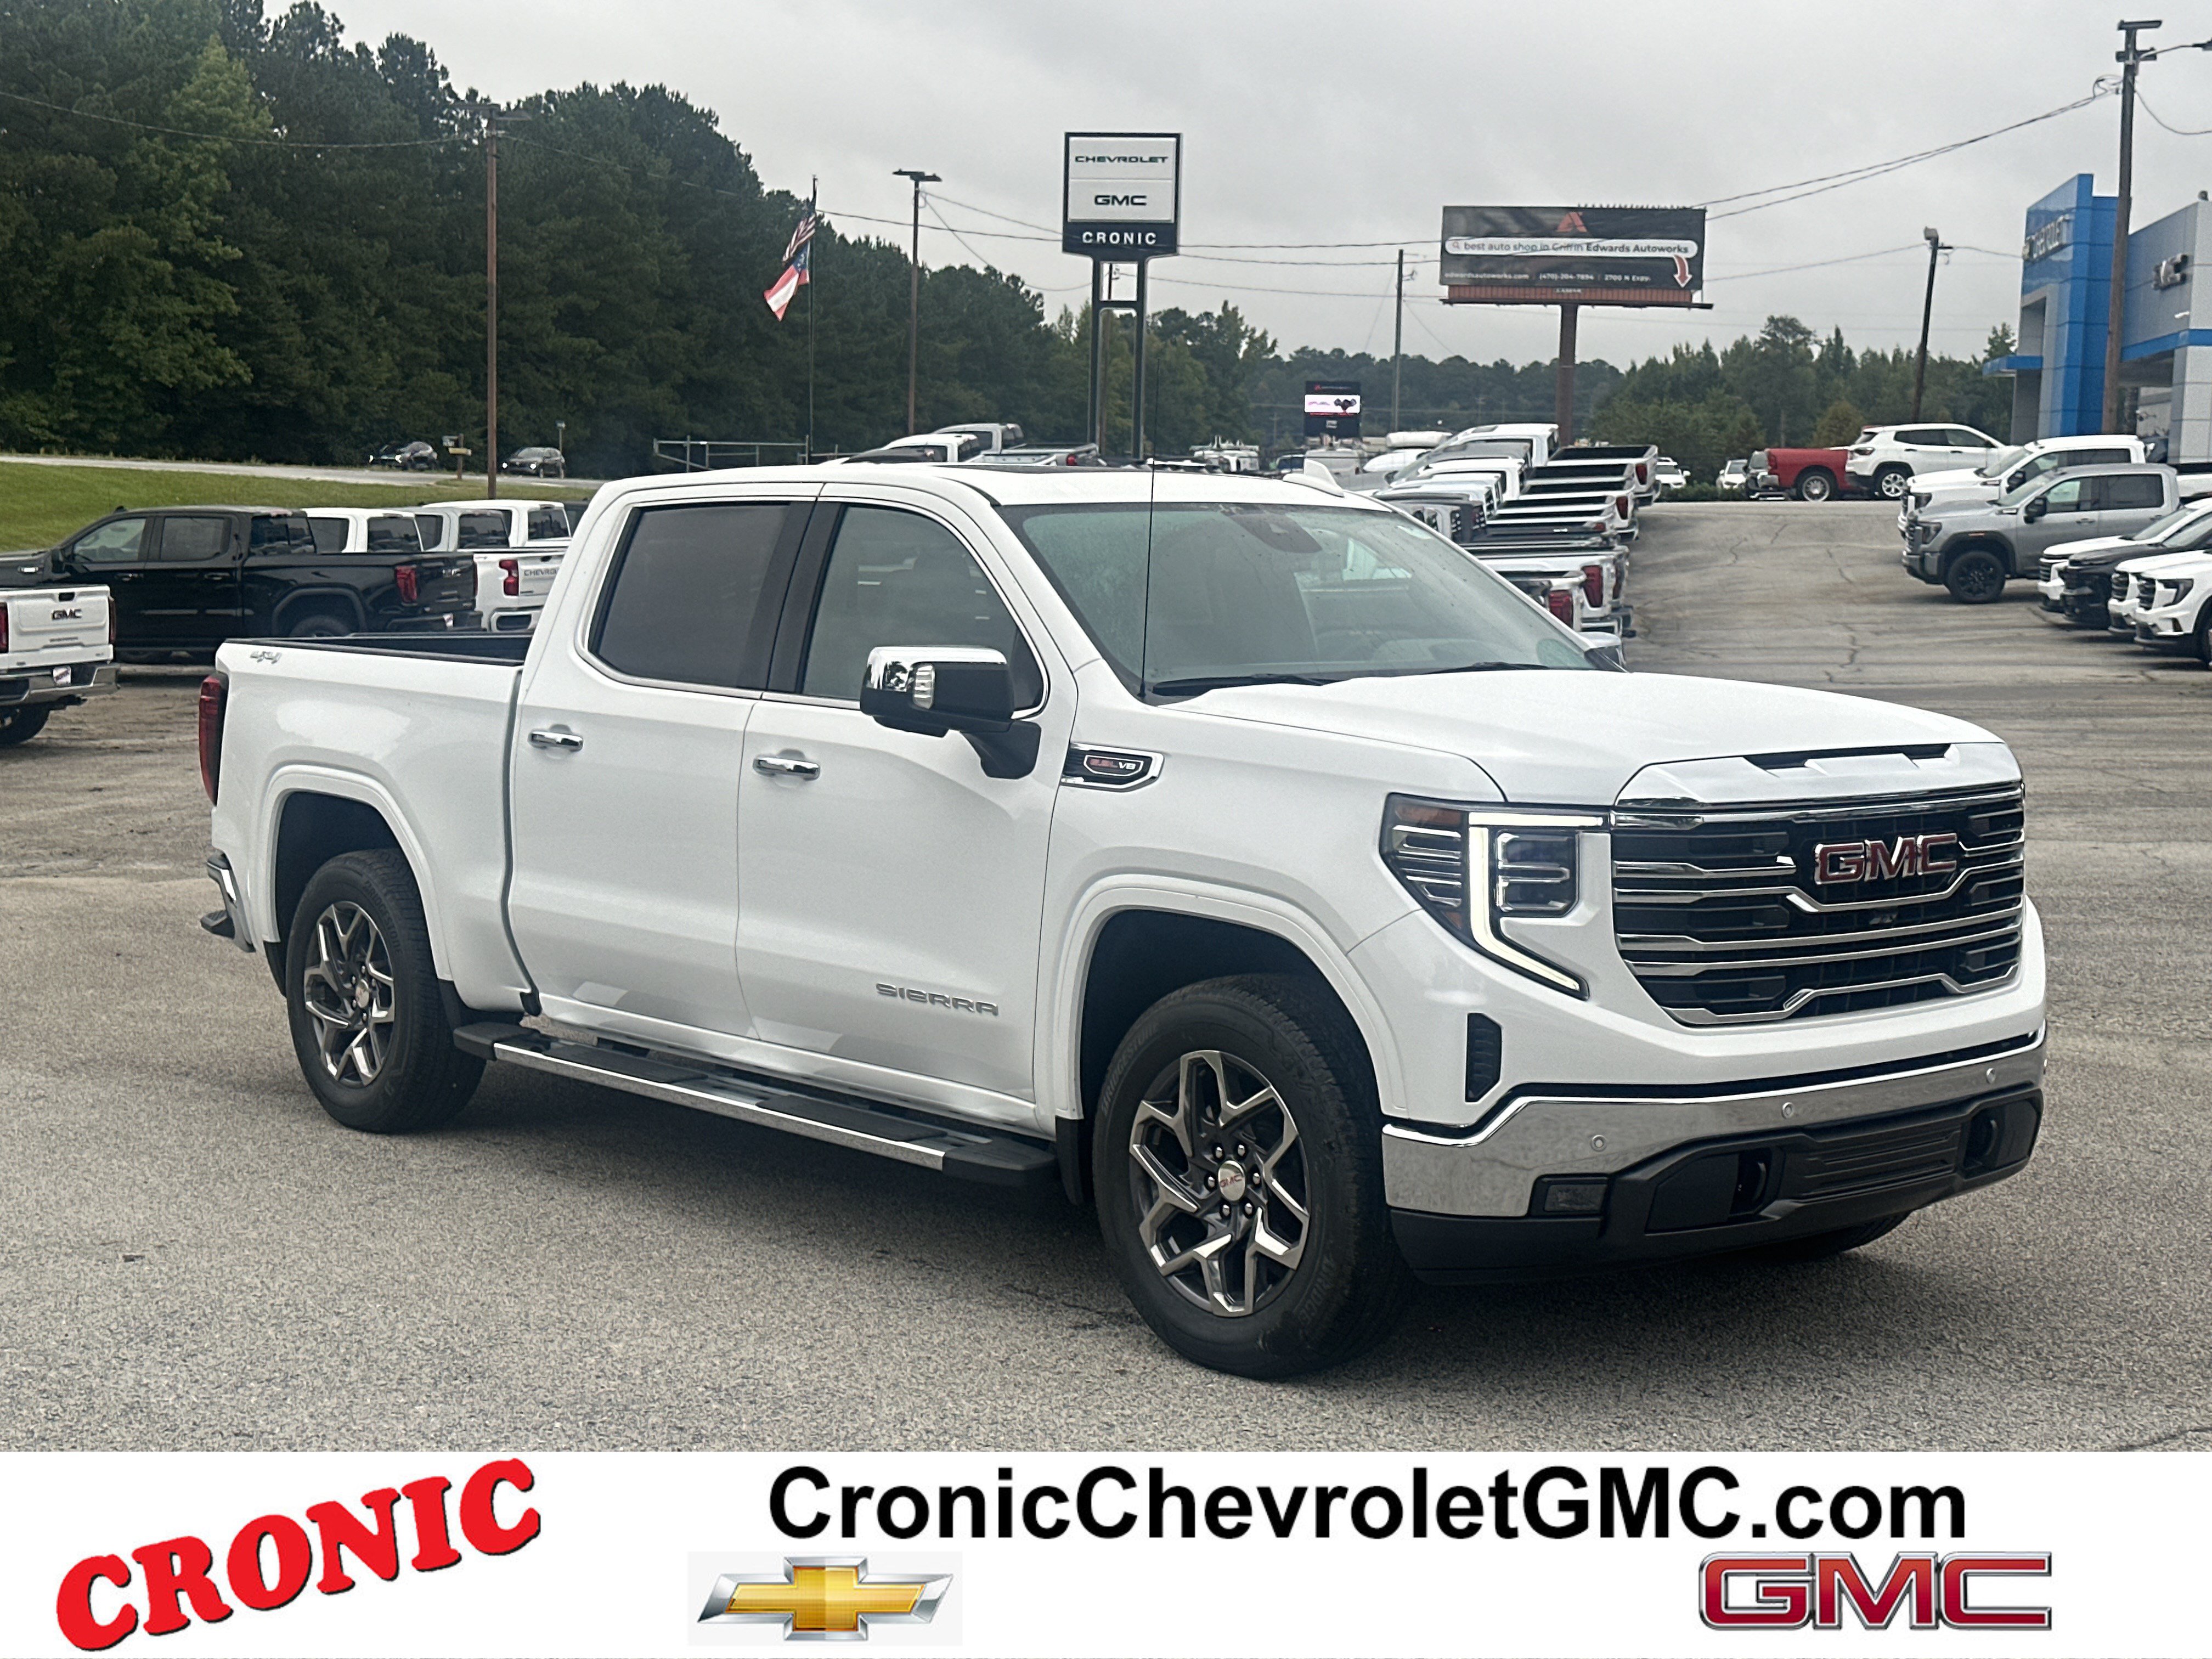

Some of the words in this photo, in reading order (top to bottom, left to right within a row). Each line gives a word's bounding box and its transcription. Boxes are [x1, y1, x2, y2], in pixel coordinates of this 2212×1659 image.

[1094, 195, 1147, 206] GMC
[1082, 231, 1156, 245] CRONIC
[1464, 241, 1486, 251] best
[1488, 242, 1511, 251] auto
[1513, 242, 1537, 253] shop
[1586, 244, 1630, 252] Edwards
[1632, 244, 1690, 254] Autoworks
[51, 608, 82, 620] GMC
[1119, 761, 1136, 770] V8
[1814, 832, 1957, 885] GMC
[876, 983, 1000, 1016] SIERRA
[1220, 1173, 1245, 1187] GMC
